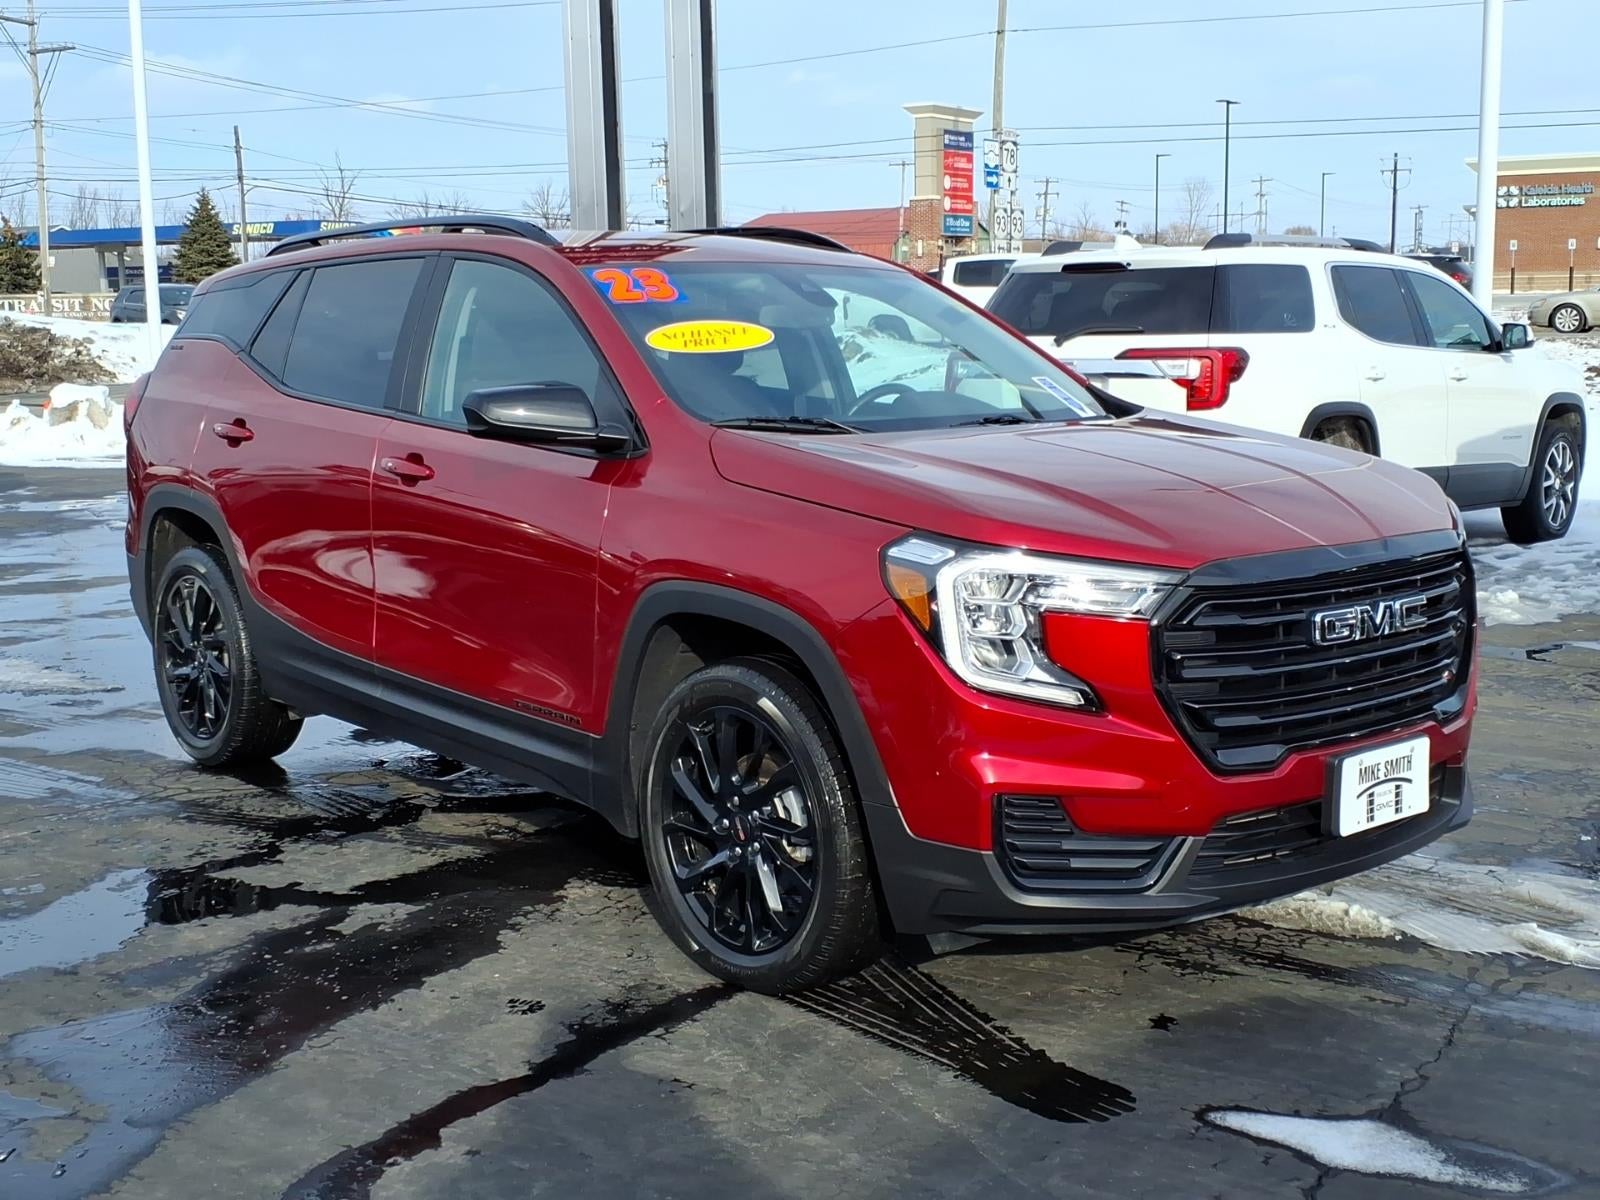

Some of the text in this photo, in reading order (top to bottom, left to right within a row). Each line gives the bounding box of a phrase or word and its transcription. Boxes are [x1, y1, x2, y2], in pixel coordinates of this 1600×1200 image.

[1004, 148, 1015, 165] 78
[1561, 182, 1595, 194] Health
[1521, 195, 1585, 207] Laboratories
[231, 222, 275, 235] SNOCO
[996, 216, 1006, 233] 93
[1013, 216, 1022, 233] 93
[593, 268, 679, 303] 23
[662, 331, 685, 342] NO
[683, 335, 731, 348] PRICE
[1312, 595, 1427, 645] GMC
[1359, 754, 1413, 785] MIKE SMITH
[1376, 801, 1394, 811] GMC
